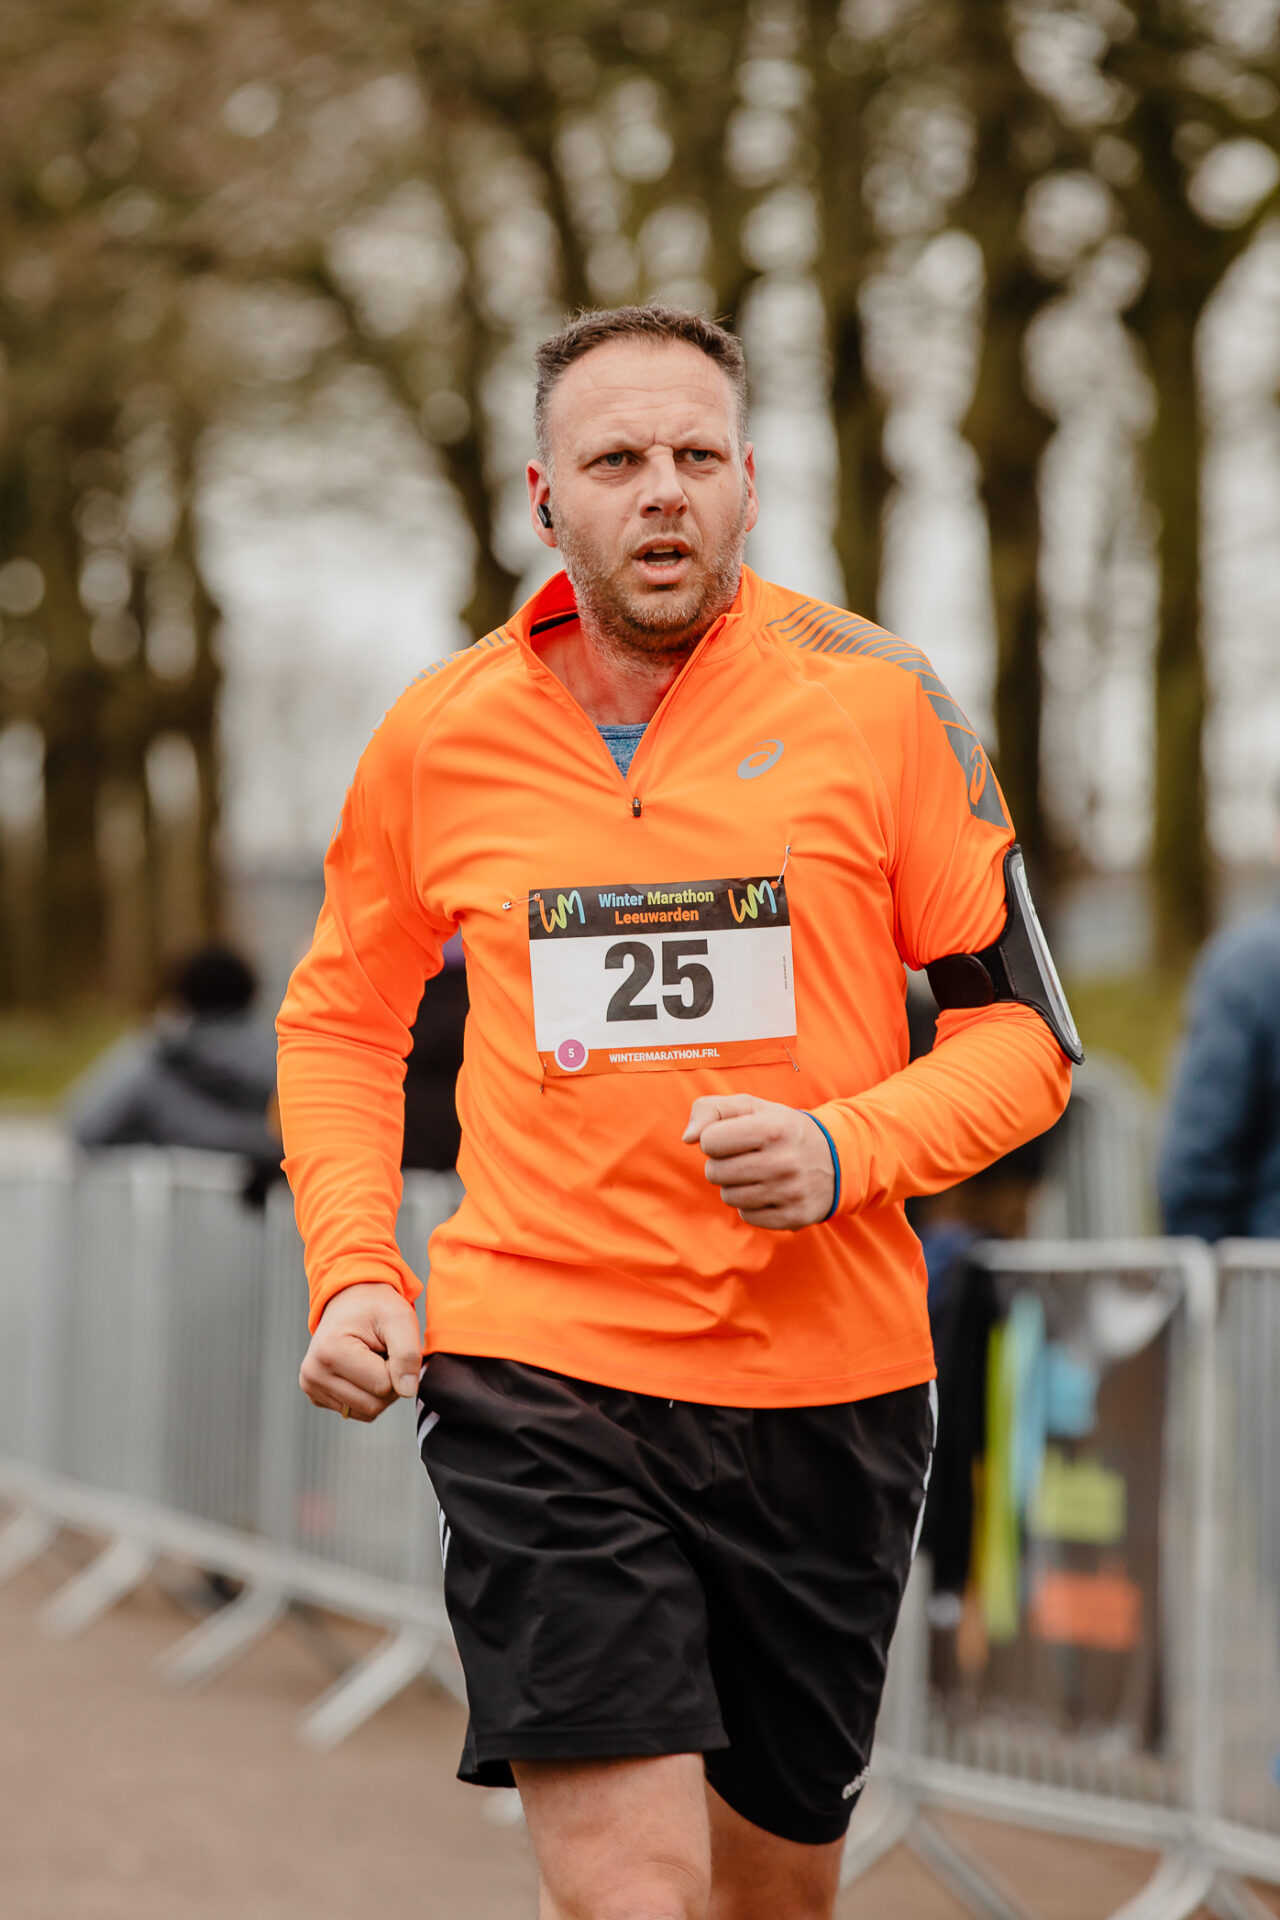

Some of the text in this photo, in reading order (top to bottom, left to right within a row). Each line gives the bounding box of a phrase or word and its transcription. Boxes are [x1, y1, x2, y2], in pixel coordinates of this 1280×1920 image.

[598, 889, 714, 908] Winter Marathon
[614, 907, 699, 925] Leeuwarden
[604, 939, 714, 1023] 25
[568, 1048, 575, 1059] 5
[609, 1048, 720, 1063] WINTERMARATHON.FRL
